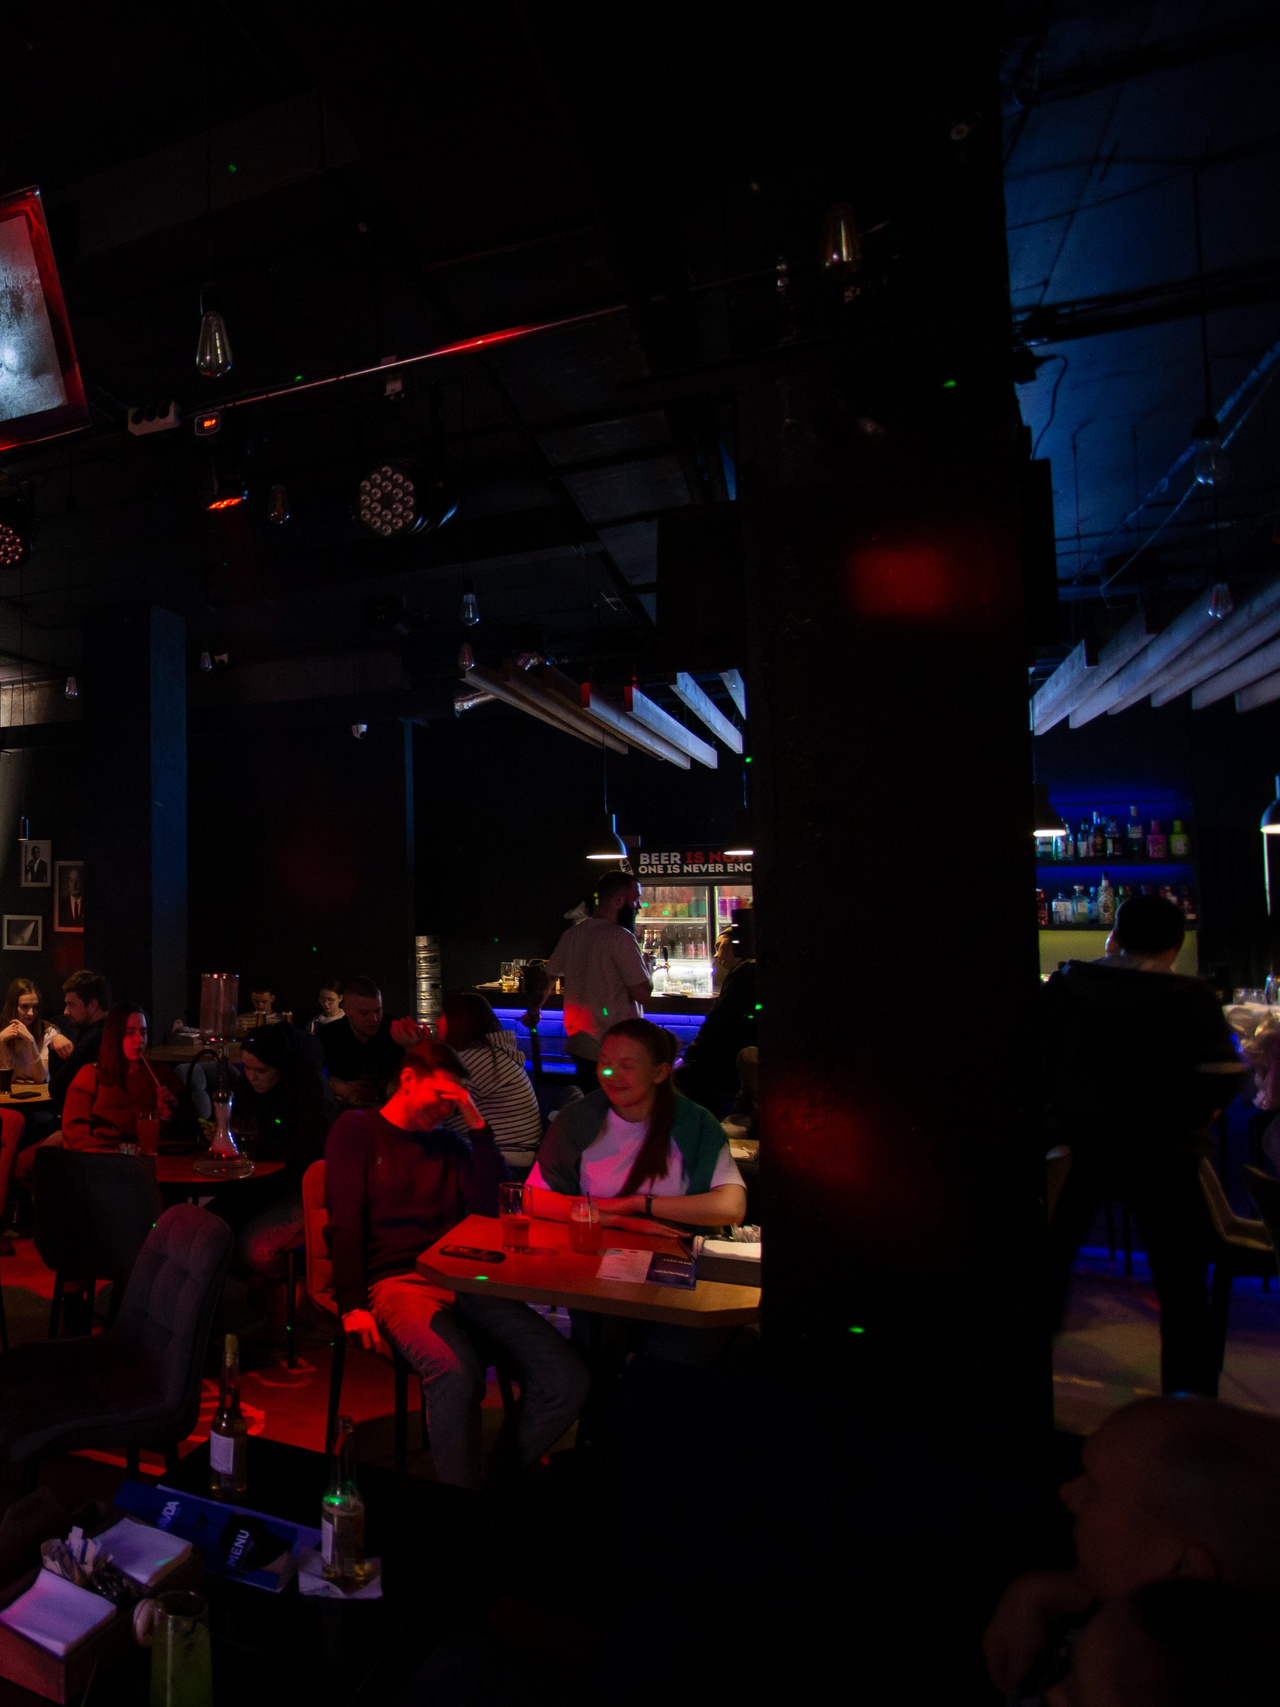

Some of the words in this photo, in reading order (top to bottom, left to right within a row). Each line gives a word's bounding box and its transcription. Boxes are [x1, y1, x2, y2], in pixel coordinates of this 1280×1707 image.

[639, 852, 681, 865] BEER
[686, 852, 705, 864] IS
[638, 864, 664, 874] ONE
[667, 864, 681, 873] IS
[683, 863, 724, 874] NEVER
[226, 1529, 250, 1566] MENU
